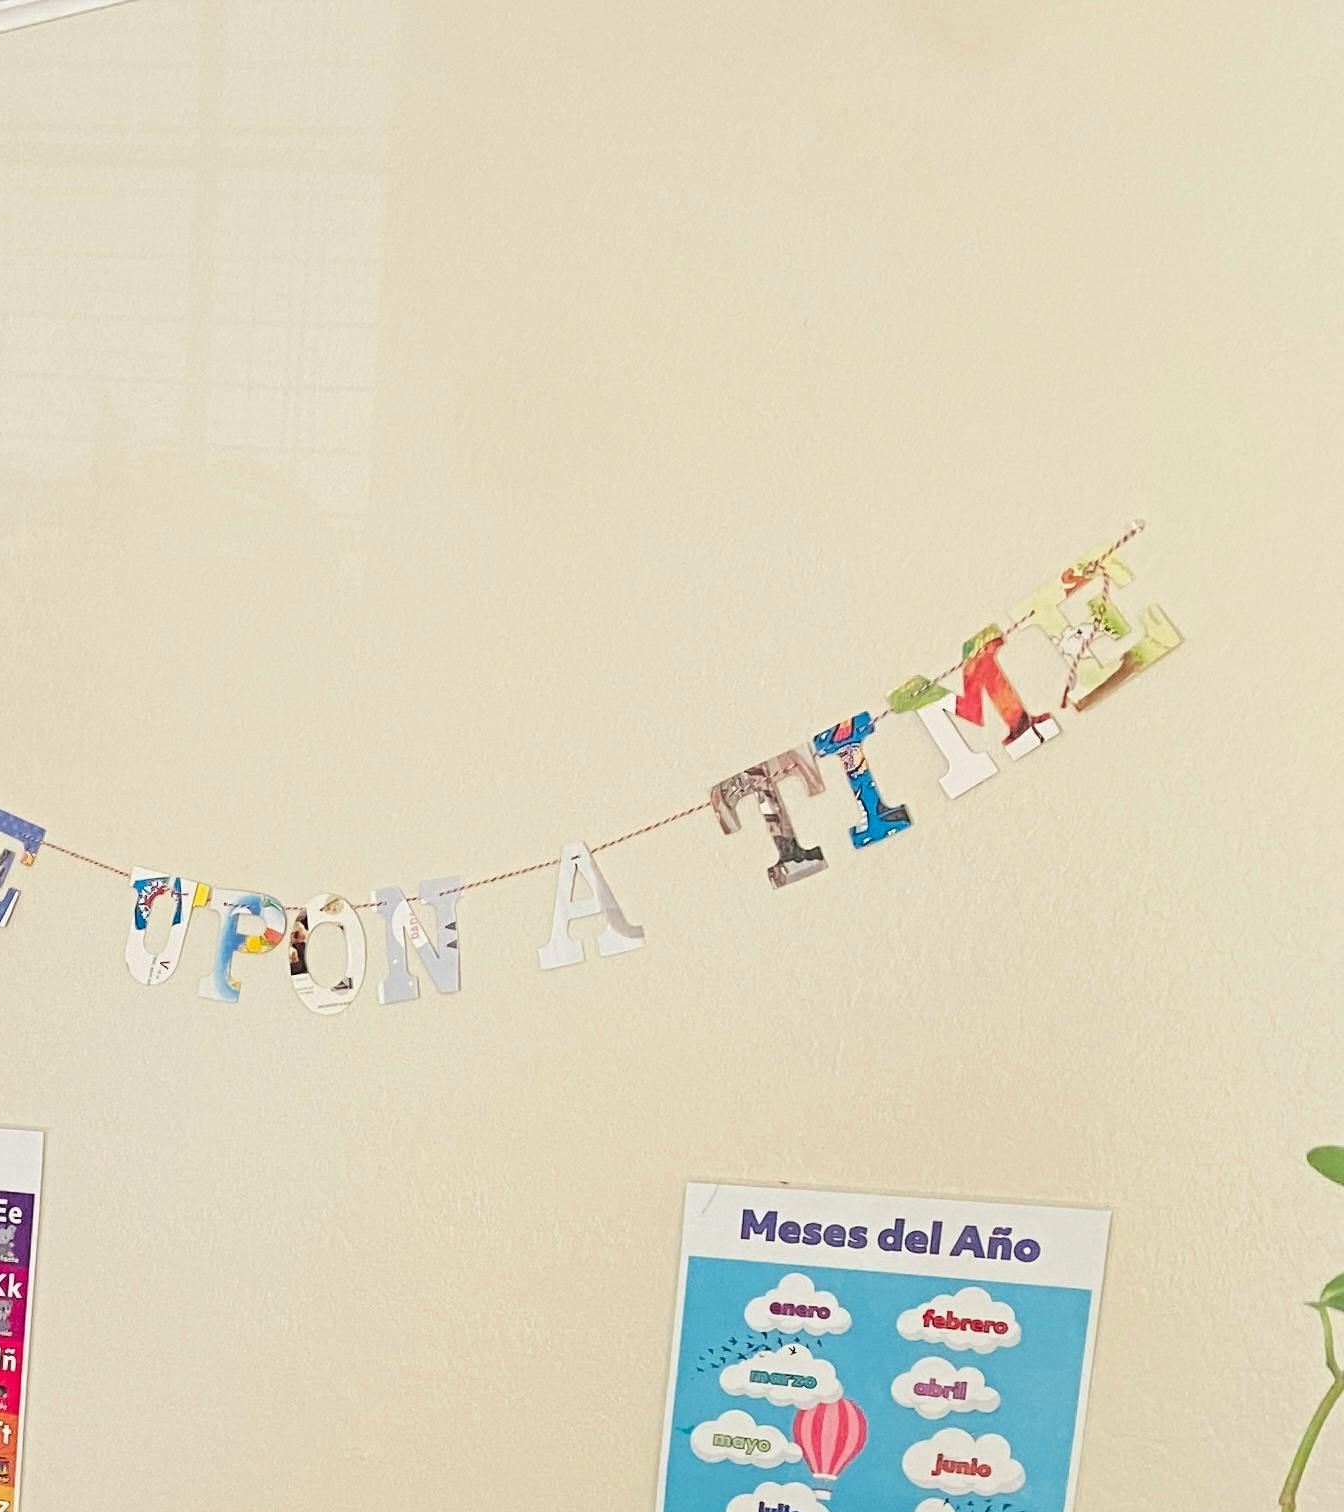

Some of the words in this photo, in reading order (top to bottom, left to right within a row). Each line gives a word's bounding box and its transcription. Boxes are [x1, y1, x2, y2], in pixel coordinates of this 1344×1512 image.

[124, 866, 463, 1016] UPON
[538, 840, 646, 970] A
[709, 541, 1186, 889] TIME
[740, 1209, 868, 1250] Meses
[877, 1218, 943, 1255] del
[950, 1225, 1041, 1263] Año
[769, 1300, 831, 1320] enero
[922, 1309, 1009, 1336] febrero
[749, 1369, 818, 1390] marzo
[913, 1378, 968, 1401] abril
[712, 1432, 772, 1456] mayo
[931, 1453, 992, 1478] junio
